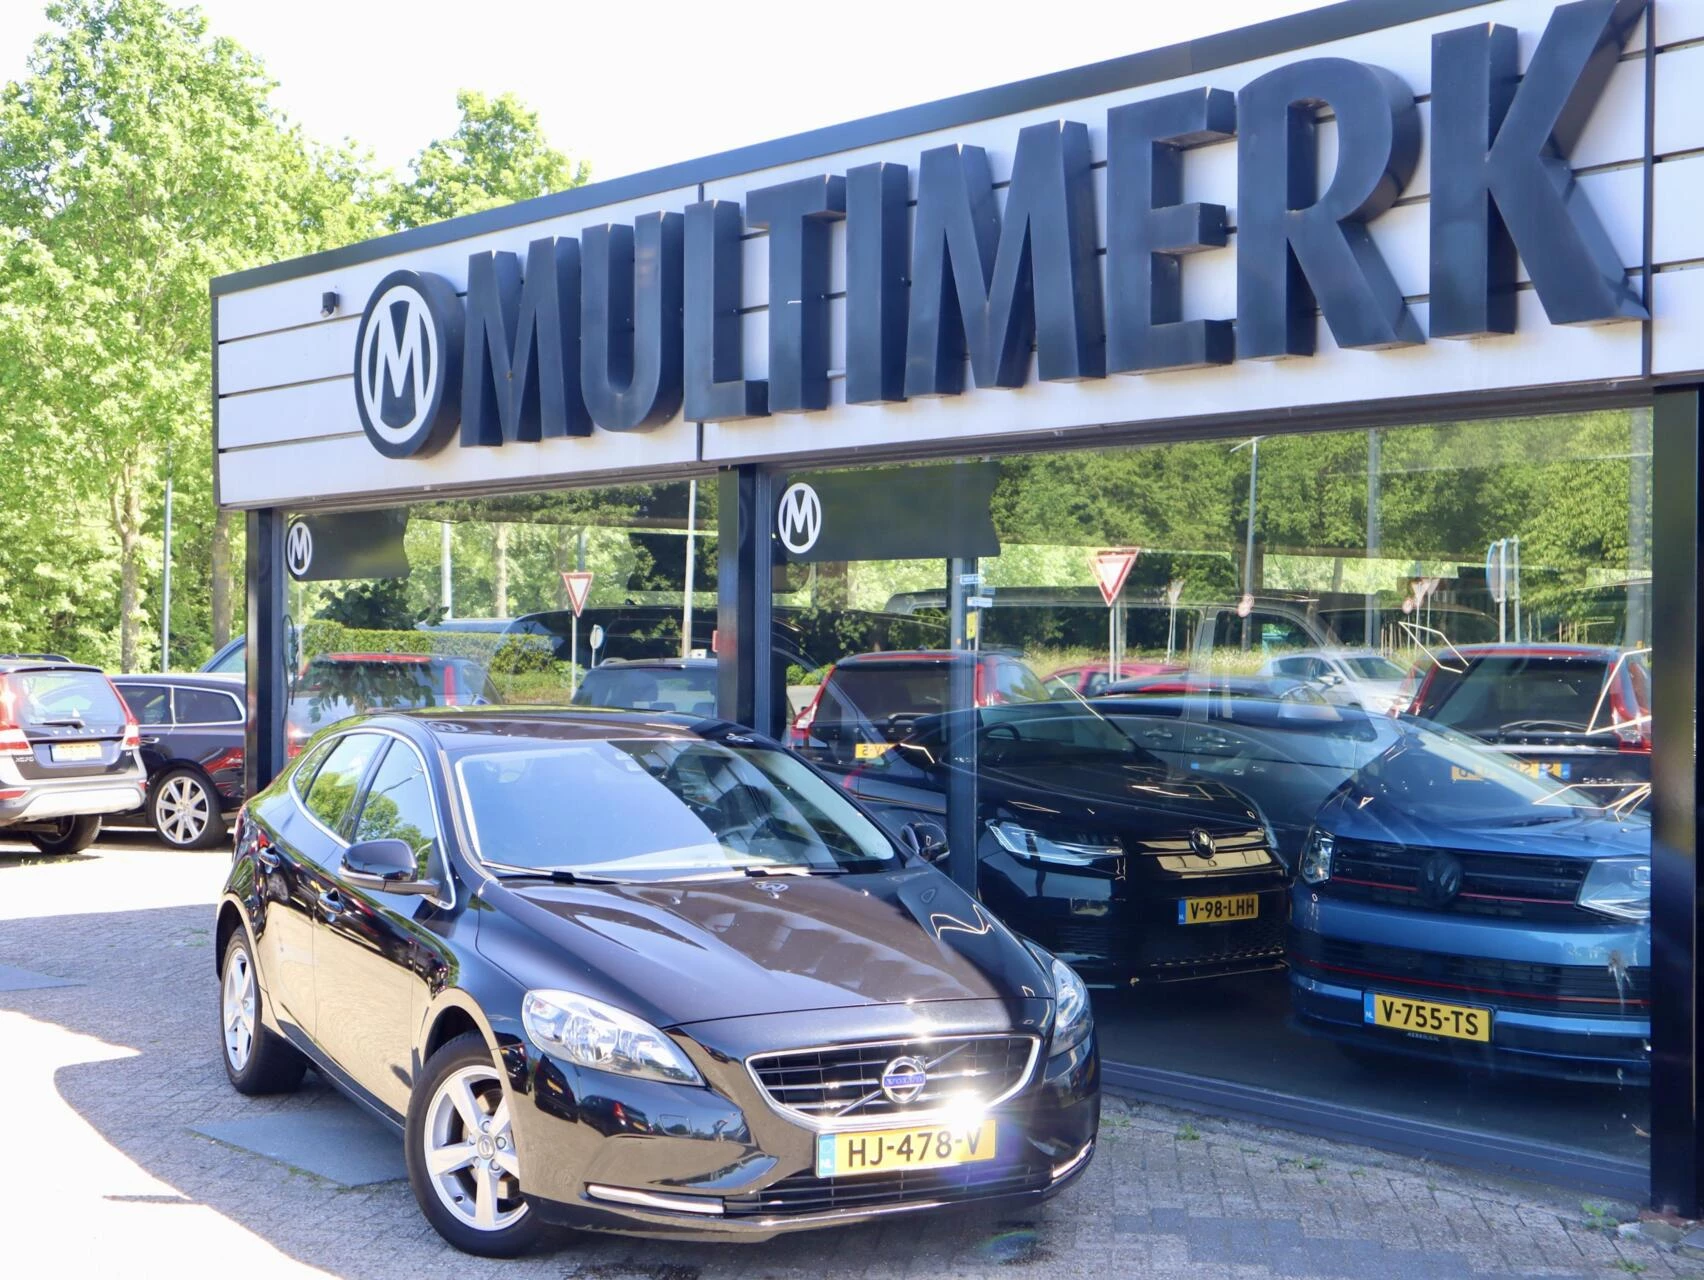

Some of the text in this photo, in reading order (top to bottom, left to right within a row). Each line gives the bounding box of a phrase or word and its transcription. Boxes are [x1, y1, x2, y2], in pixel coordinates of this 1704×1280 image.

[361, 0, 1650, 449] M MULTIMERK
[778, 482, 822, 554] M
[287, 522, 312, 576] M
[1190, 897, 1256, 919] V-98-LHH
[1381, 999, 1480, 1036] V-755-TS
[848, 1127, 981, 1168] HJ-478-V
